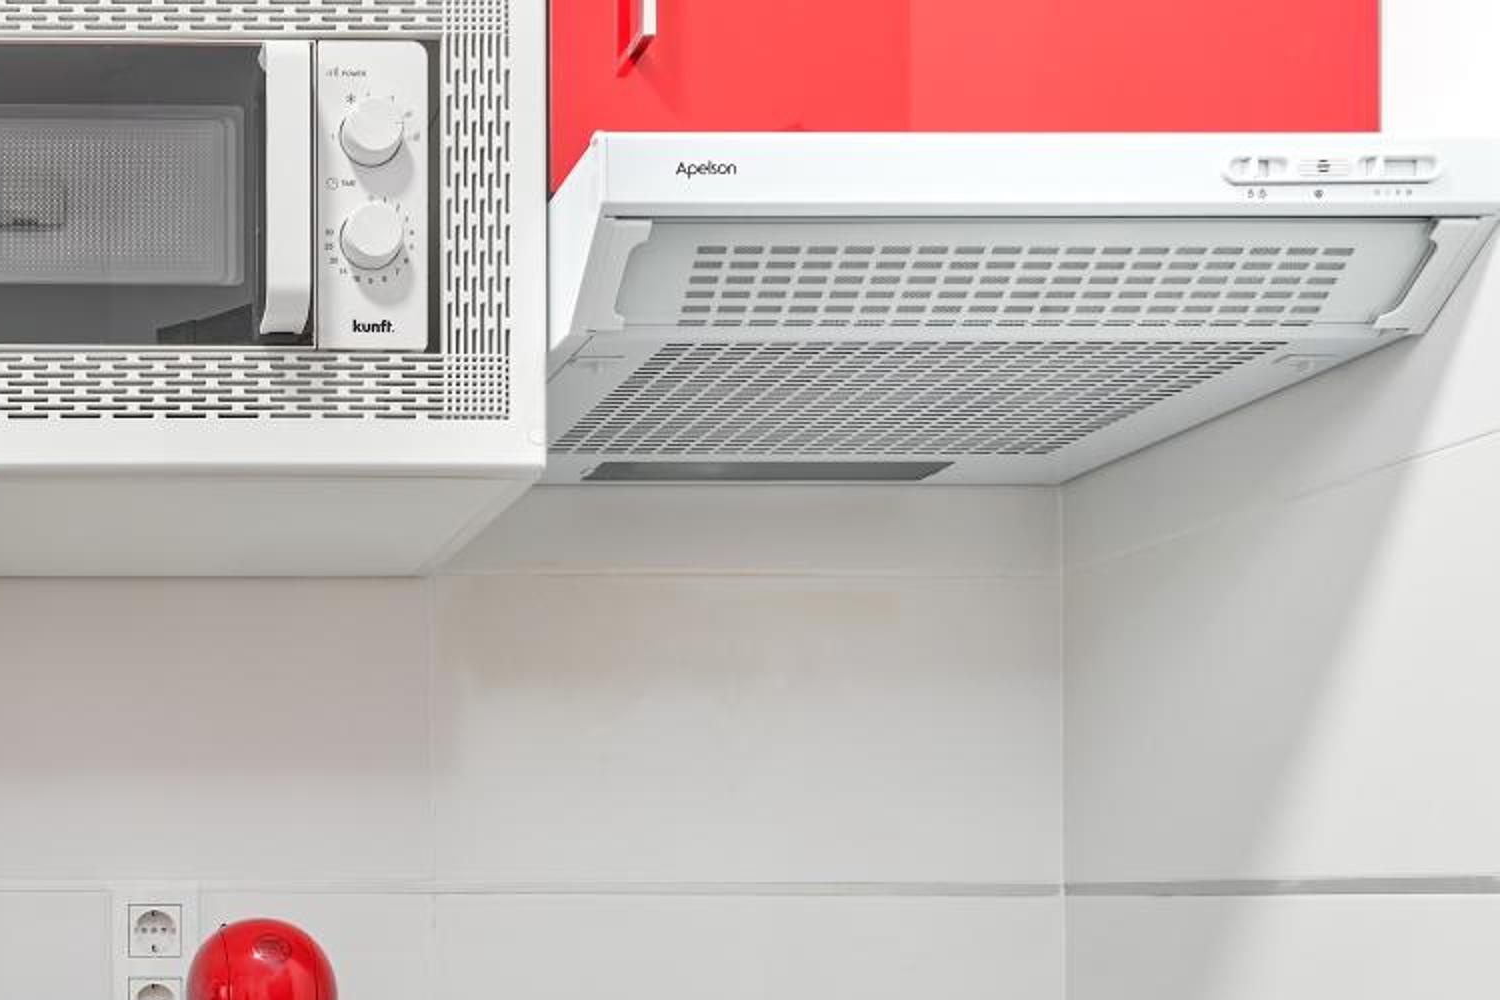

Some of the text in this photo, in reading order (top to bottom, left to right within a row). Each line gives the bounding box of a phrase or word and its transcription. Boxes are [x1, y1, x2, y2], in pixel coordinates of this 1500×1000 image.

[341, 70, 367, 78] POWER
[675, 160, 737, 180] Apelson
[352, 318, 395, 334] kunft.
